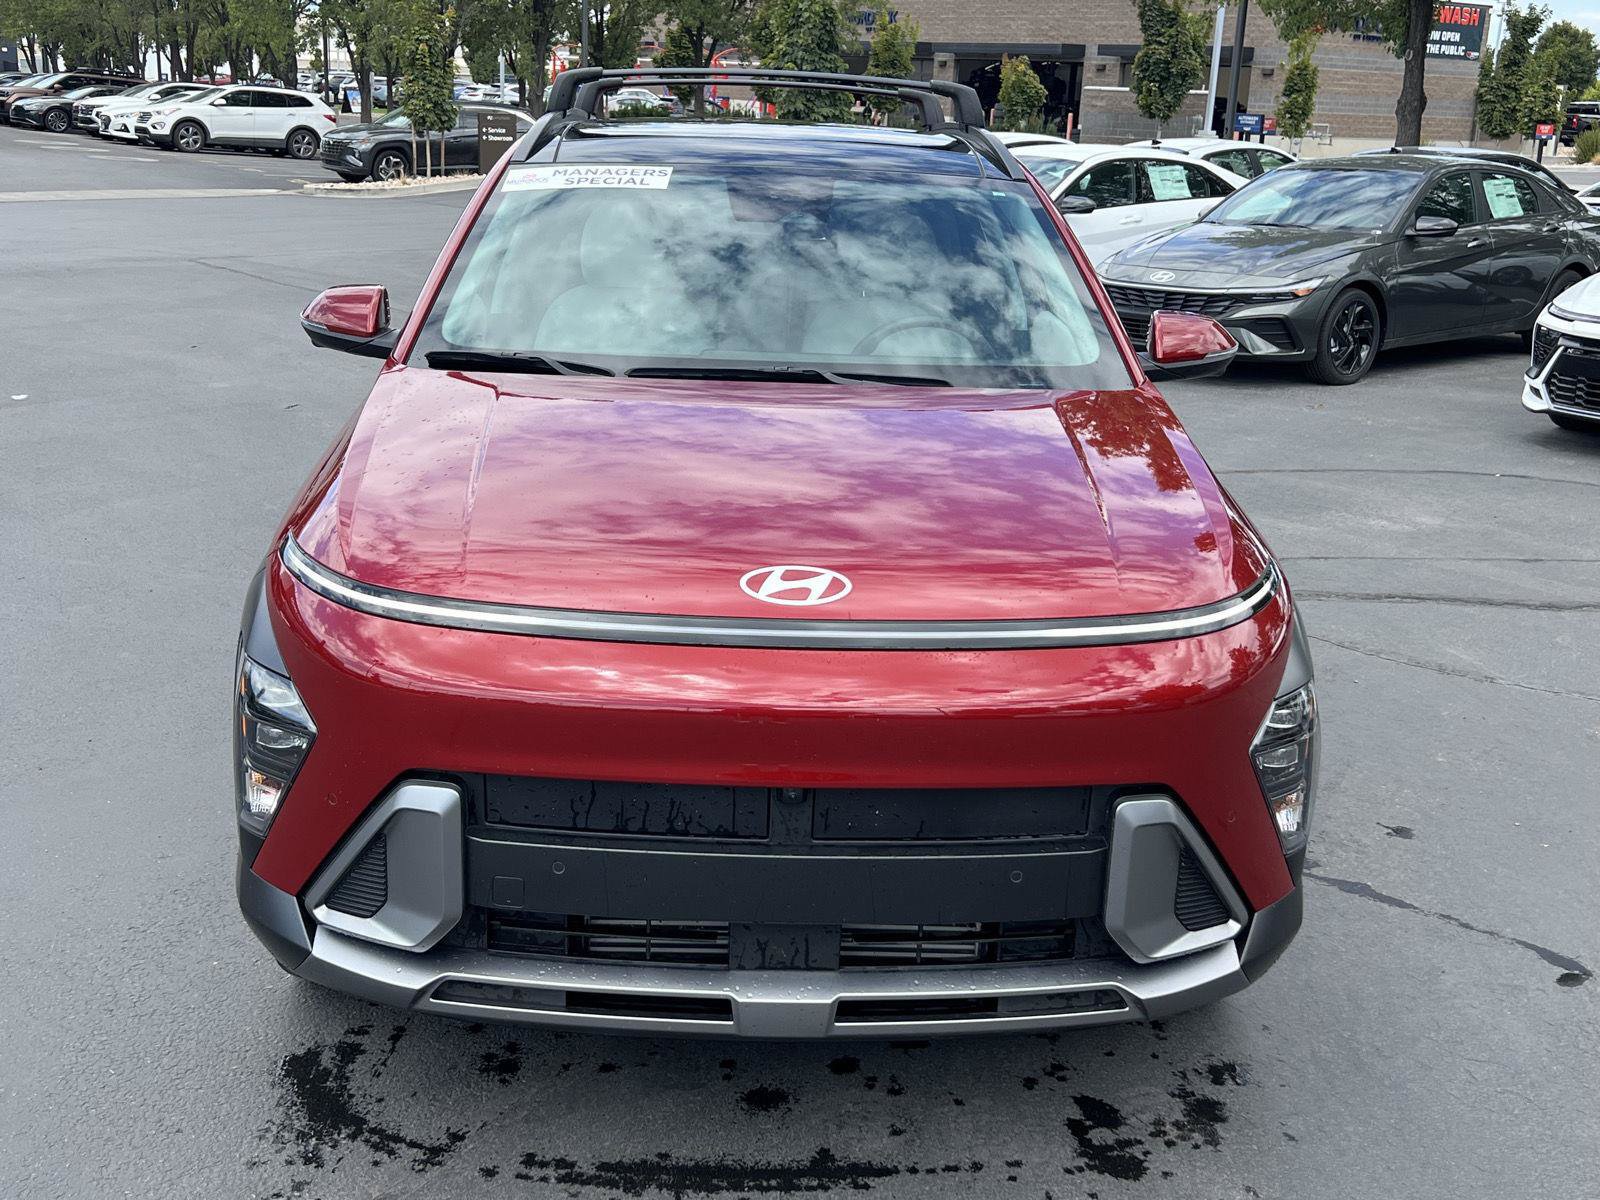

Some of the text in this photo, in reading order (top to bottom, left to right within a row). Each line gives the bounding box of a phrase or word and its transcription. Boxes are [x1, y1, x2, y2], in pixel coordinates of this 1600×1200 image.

[1439, 5, 1480, 26] WASH
[1441, 31, 1461, 42] OPEN
[1426, 43, 1440, 54] THE
[1440, 44, 1466, 56] PUBLIC
[487, 134, 514, 142] Showroom
[552, 168, 669, 177] MANAGERS
[564, 177, 650, 186] SPECIAL
